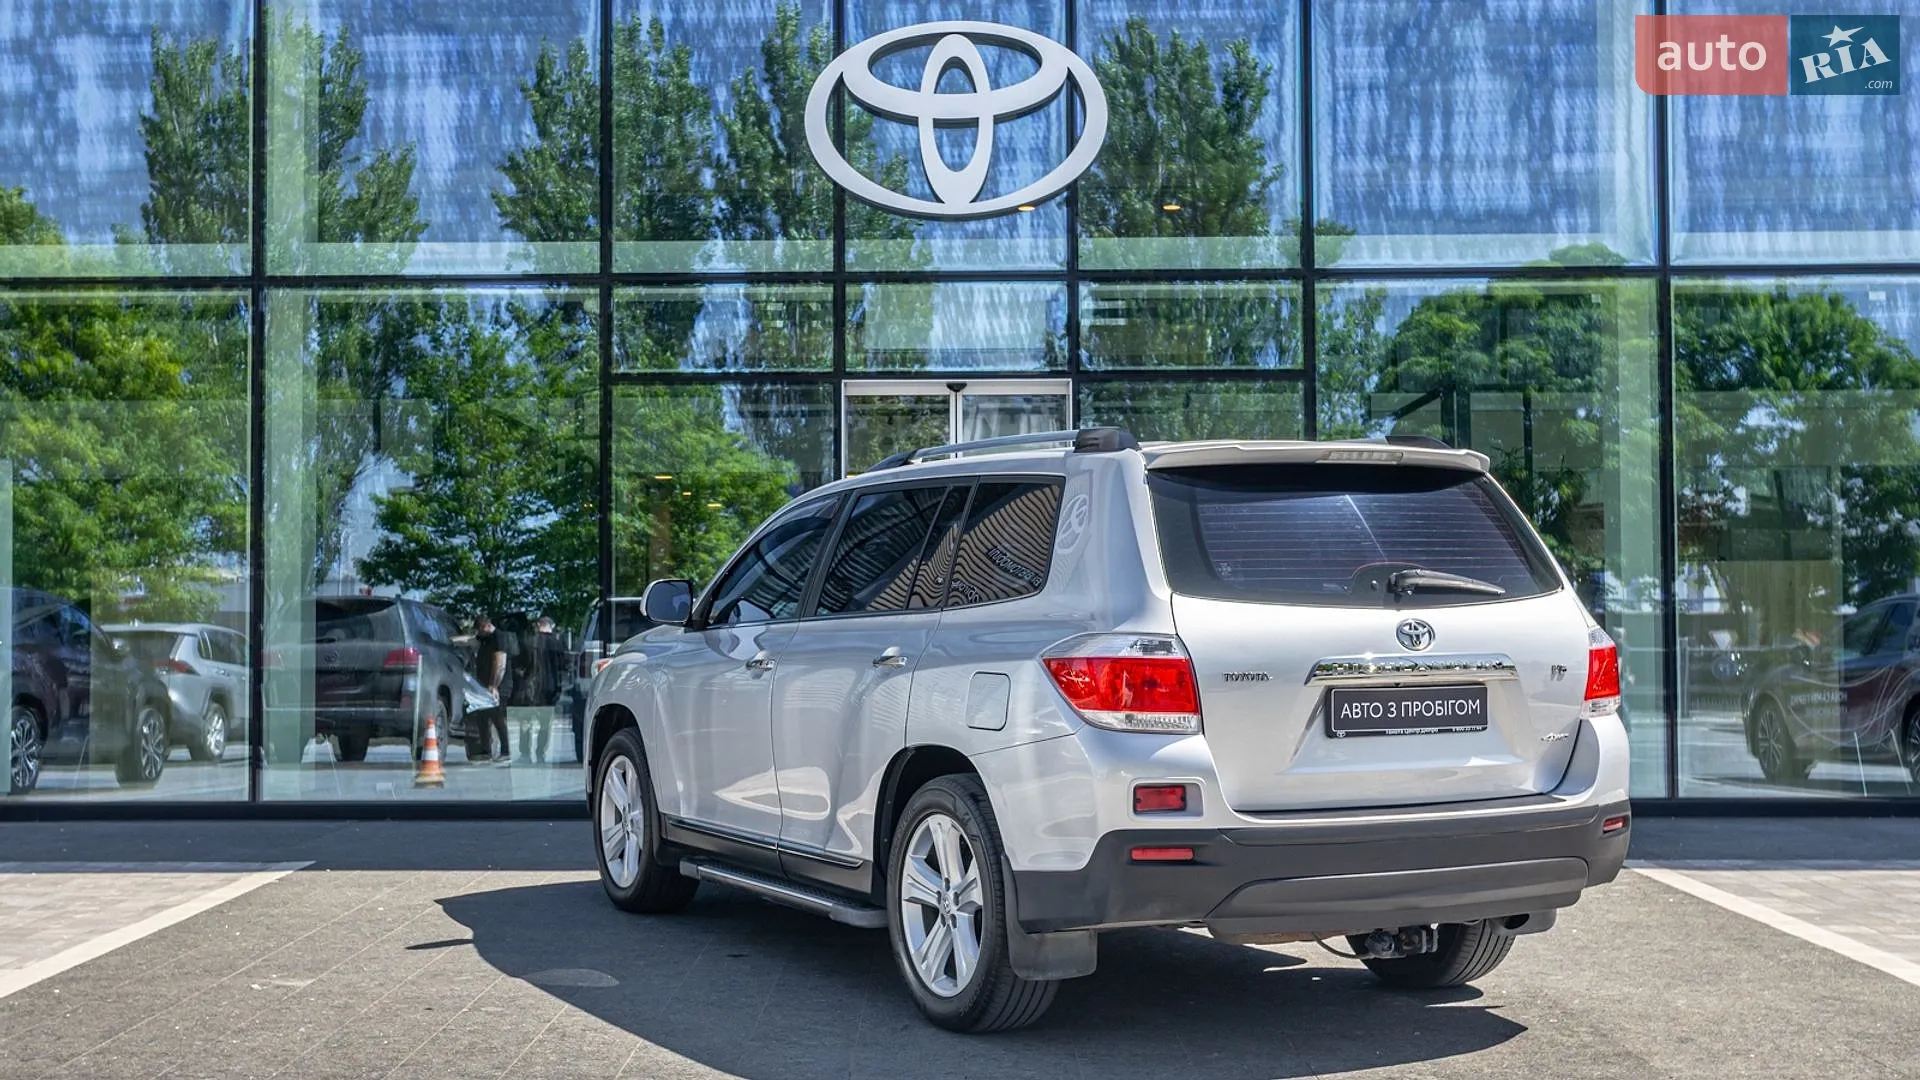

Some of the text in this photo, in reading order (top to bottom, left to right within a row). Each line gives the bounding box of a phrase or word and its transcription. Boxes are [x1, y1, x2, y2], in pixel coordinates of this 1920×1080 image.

[1223, 671, 1271, 682] TOYOTA
[1340, 702, 1383, 719] АВТО
[1401, 698, 1480, 717] ПРОБІГОМ
